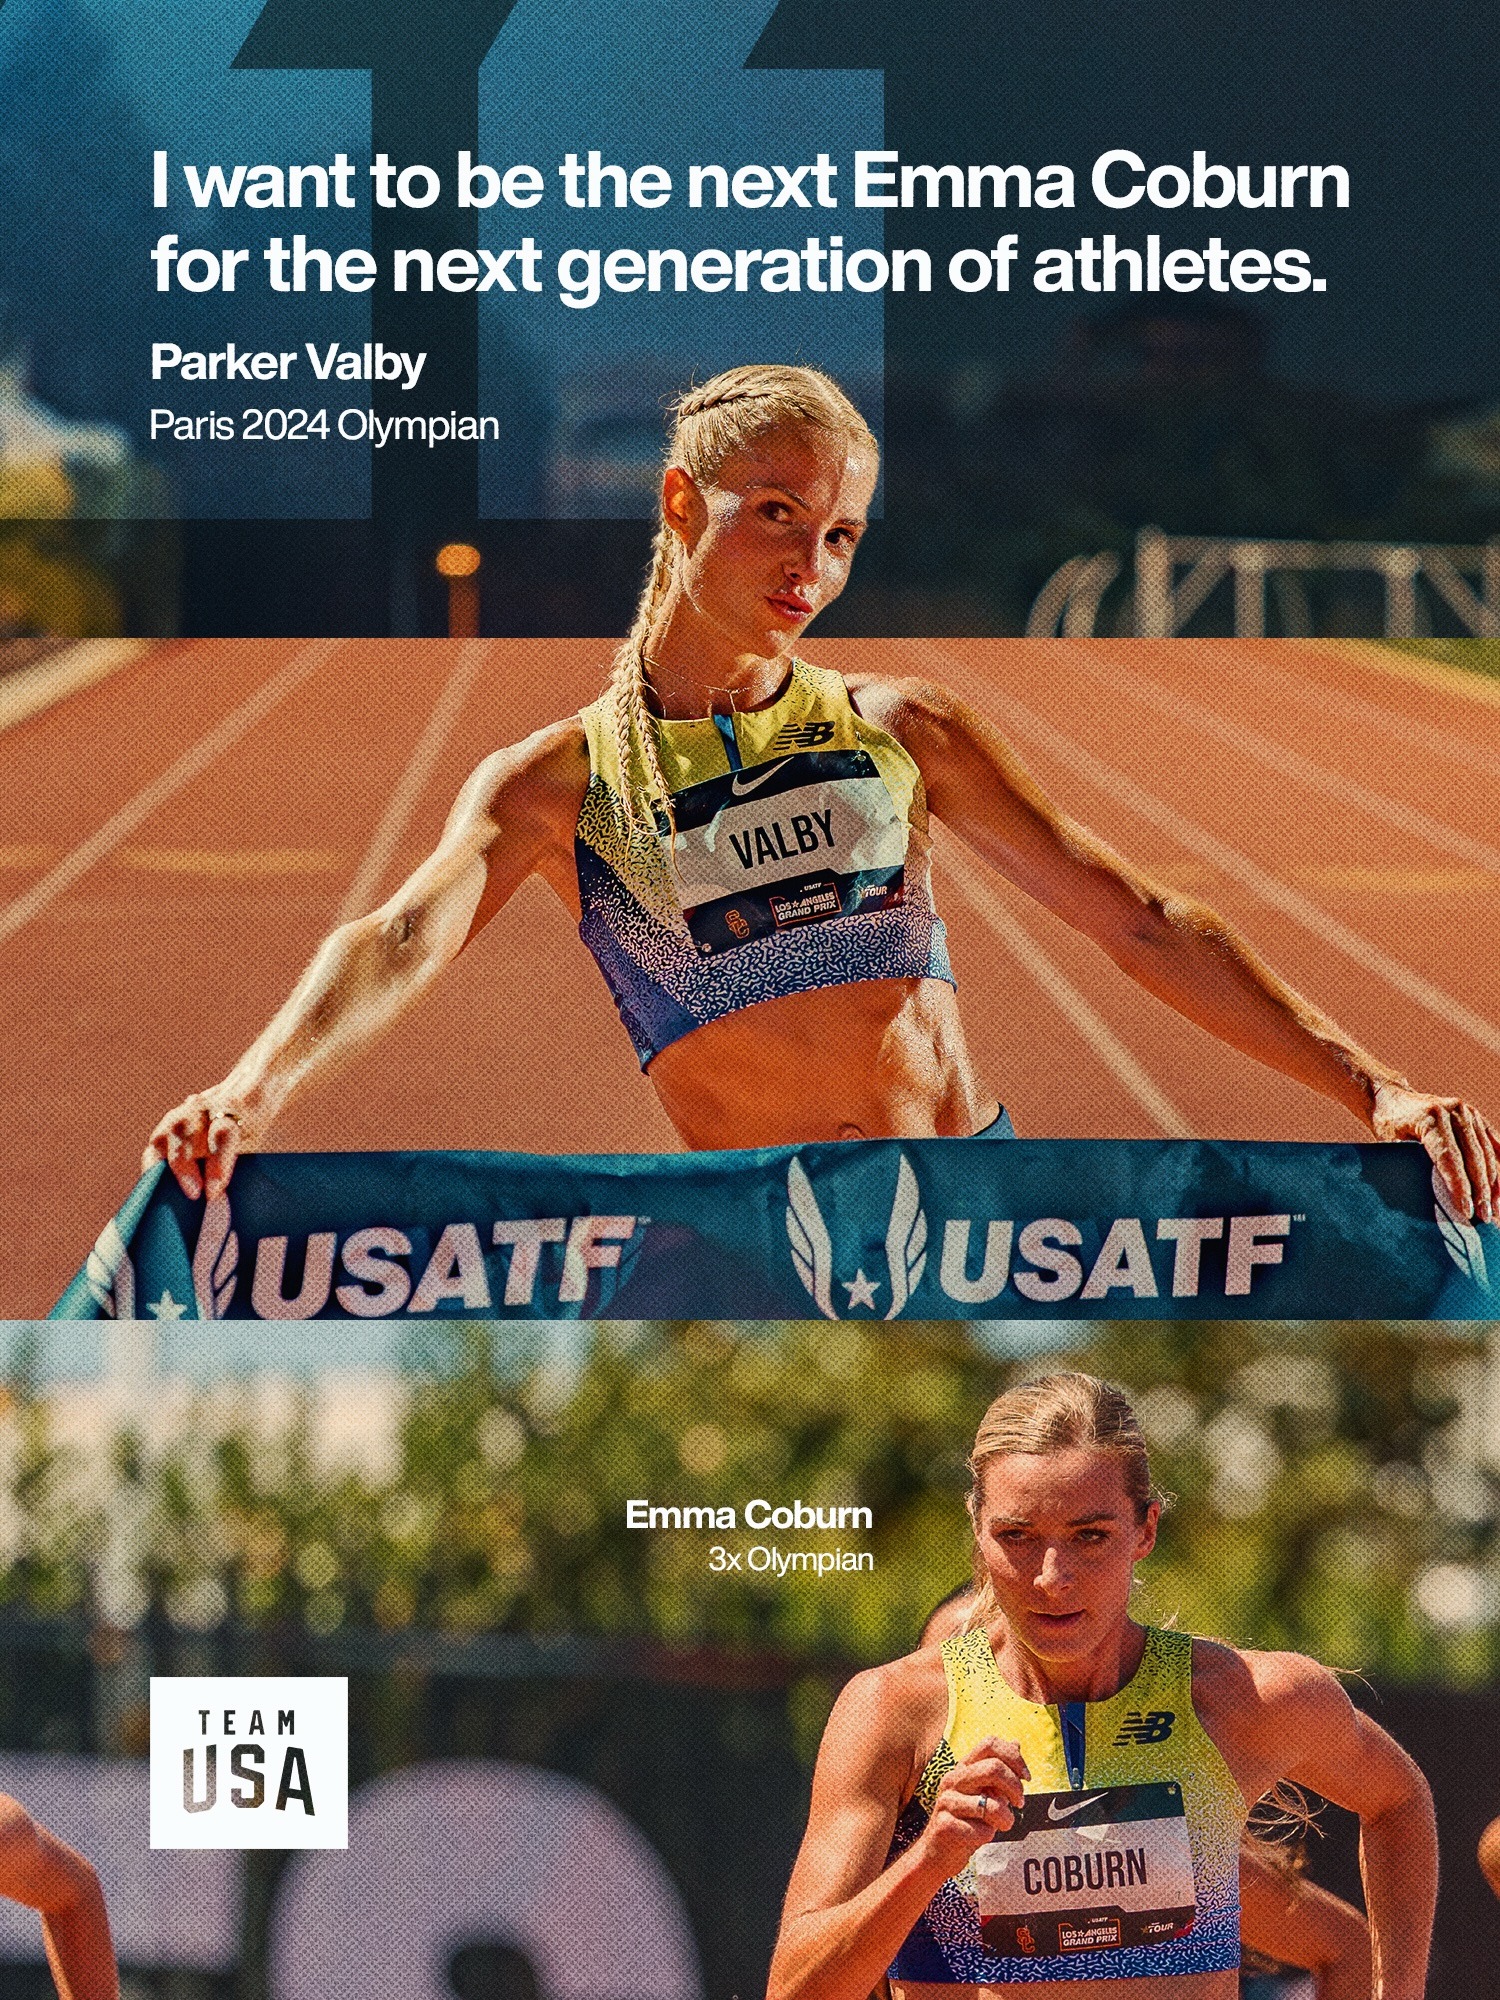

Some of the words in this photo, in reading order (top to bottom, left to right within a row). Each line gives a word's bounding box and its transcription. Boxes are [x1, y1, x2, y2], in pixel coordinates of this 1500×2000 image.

[729, 809, 835, 869] VALBY
[865, 885, 888, 898] TOUR
[775, 901, 792, 913] LOS
[800, 892, 836, 908] ANGELES
[778, 907, 812, 920] GRAND
[815, 901, 837, 912] PRIX
[251, 1215, 637, 1319] USATF
[939, 1214, 1291, 1303] USATF
[1024, 1848, 1148, 1895] COBURN
[1062, 1930, 1078, 1939] LOS
[1084, 1926, 1118, 1937] ANGELES
[1148, 1922, 1174, 1933] TOUR
[1063, 1936, 1094, 1947] GRAND
[1096, 1934, 1118, 1943] PRIX
